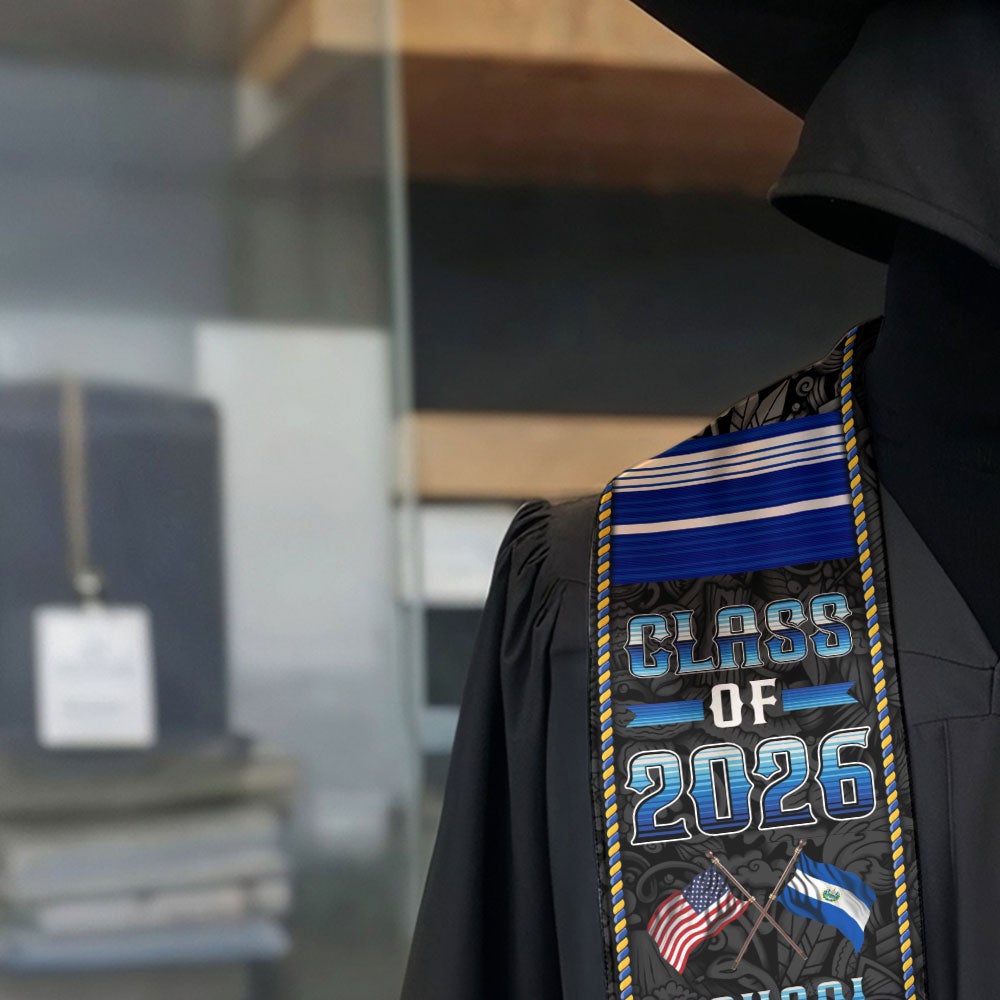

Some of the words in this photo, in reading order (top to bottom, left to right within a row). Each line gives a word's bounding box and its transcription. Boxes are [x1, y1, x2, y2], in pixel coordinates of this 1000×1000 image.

[624, 592, 853, 678] CLASS
[709, 678, 777, 728] OF
[625, 726, 877, 845] 2026
